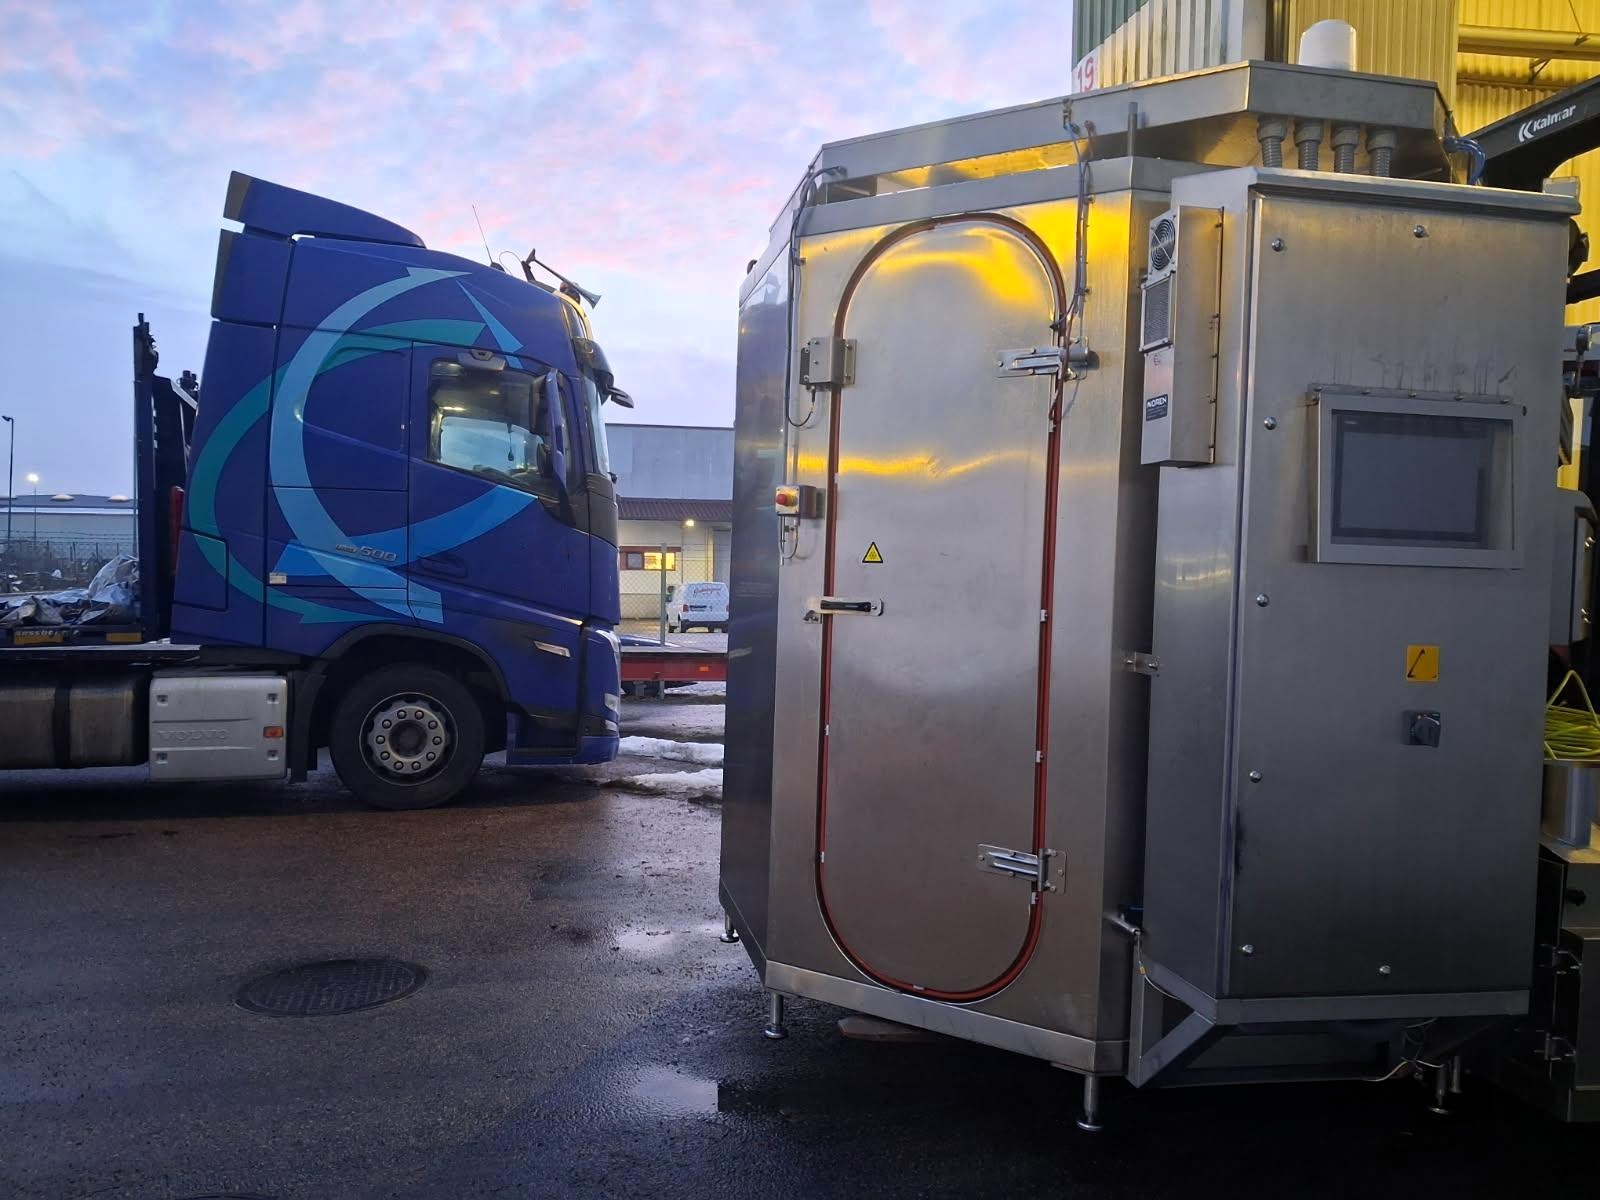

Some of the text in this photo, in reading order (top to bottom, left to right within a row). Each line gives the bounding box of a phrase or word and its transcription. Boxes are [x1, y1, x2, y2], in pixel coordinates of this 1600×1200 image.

[1077, 56, 1094, 93] 19
[1533, 105, 1577, 132] Kalmar
[360, 545, 397, 561] 500
